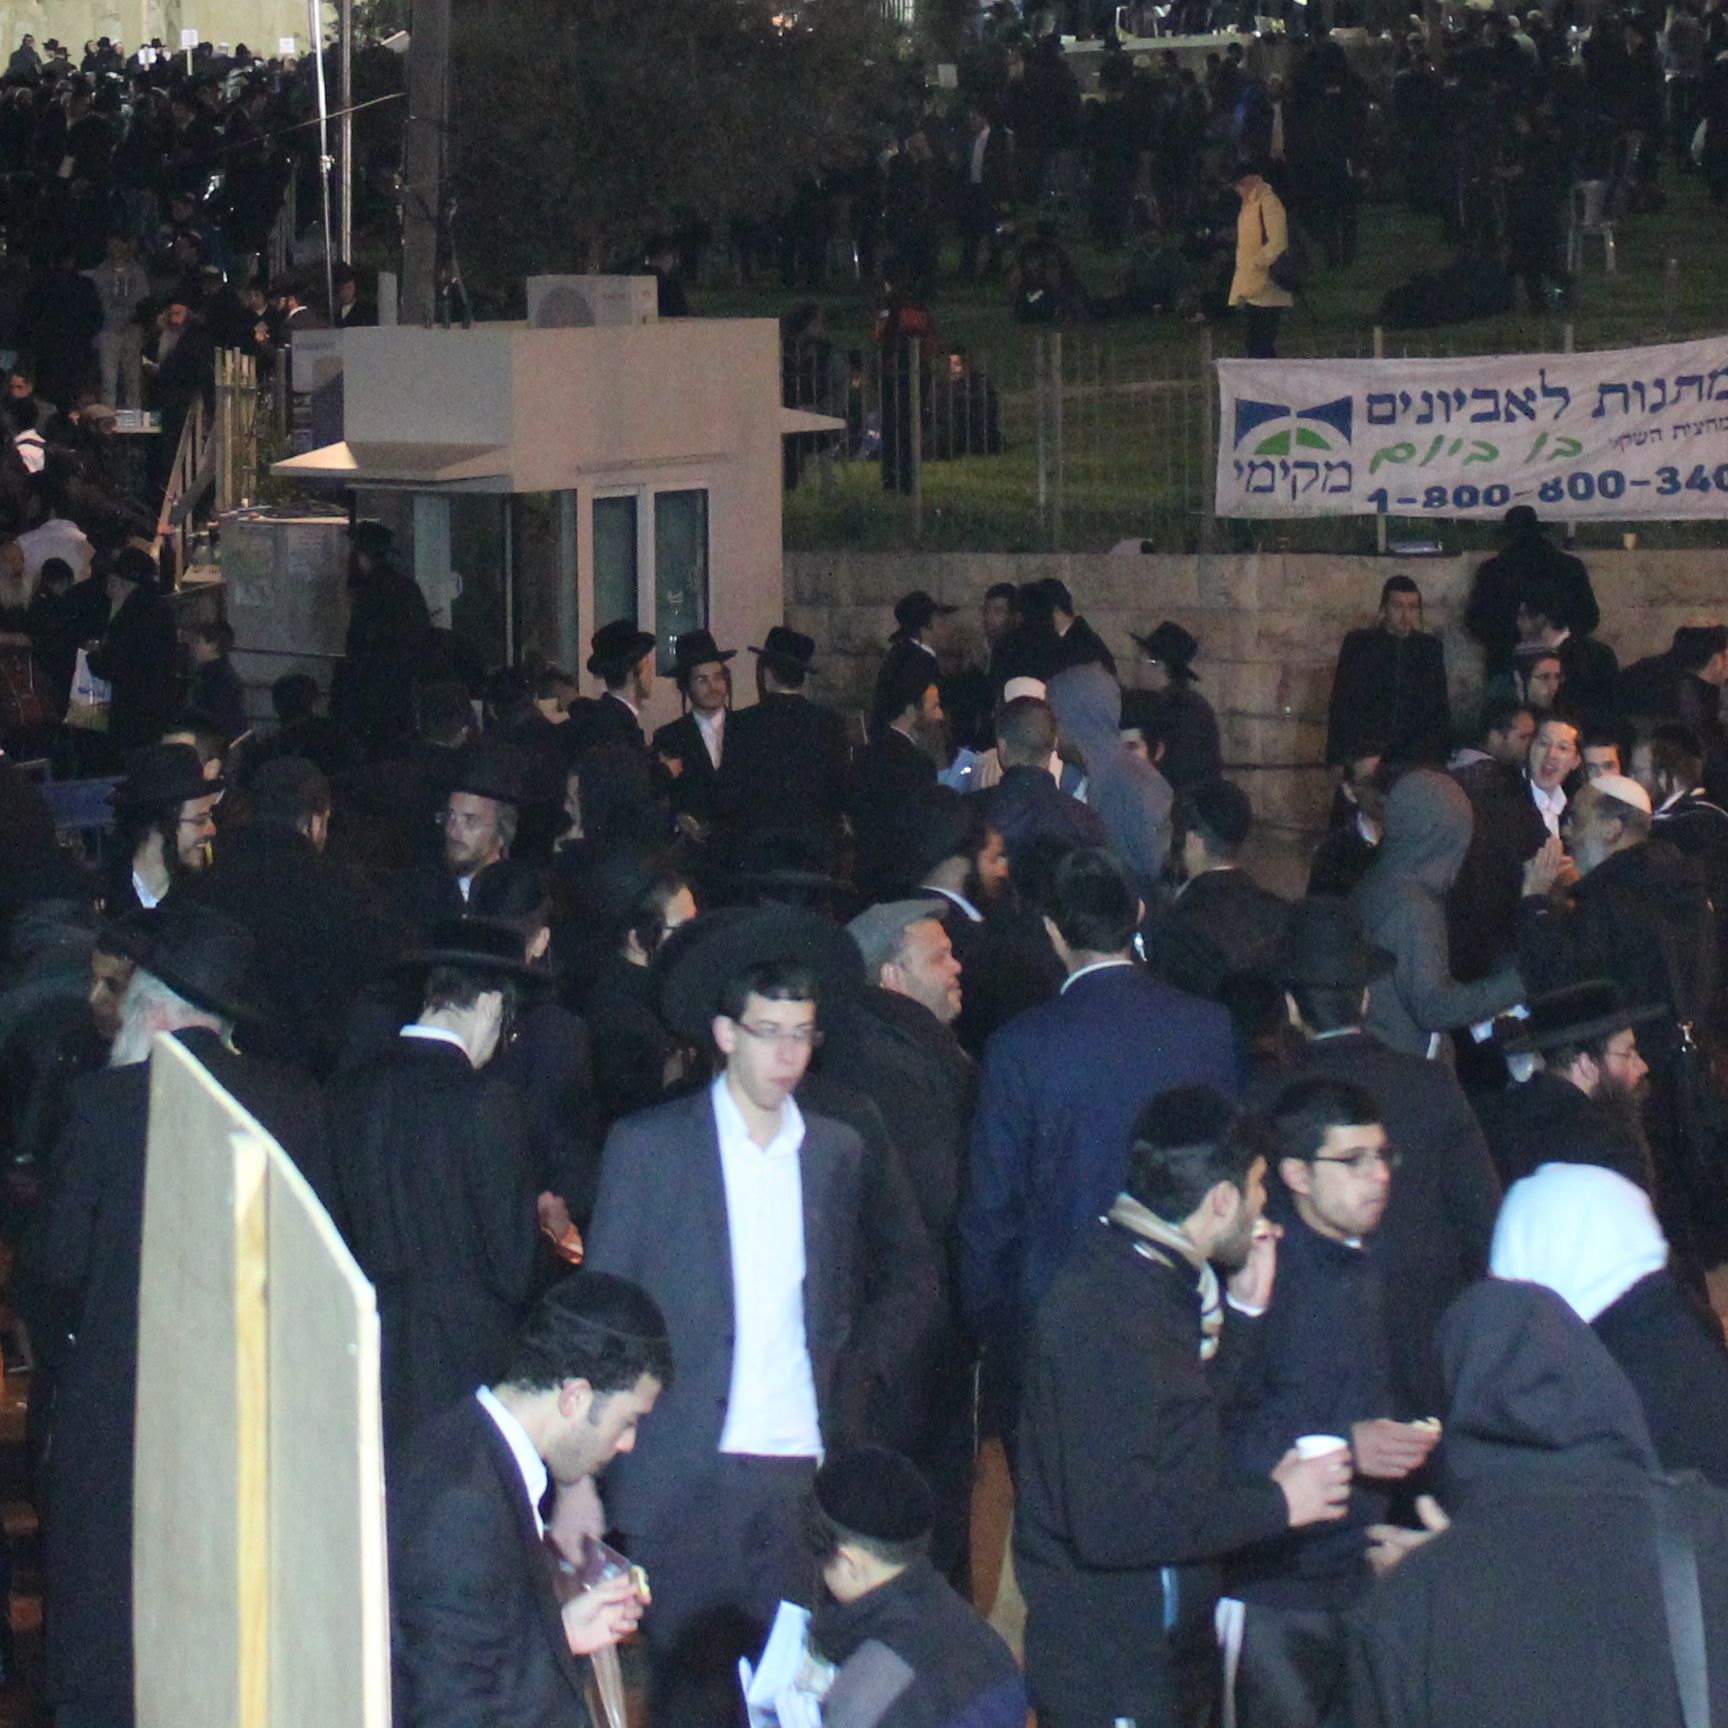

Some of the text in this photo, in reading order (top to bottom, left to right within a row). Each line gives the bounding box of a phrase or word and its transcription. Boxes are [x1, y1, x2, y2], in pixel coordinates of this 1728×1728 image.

[1367, 368, 1571, 425] לאביונים
[1368, 434, 1500, 476] ביום
[1233, 459, 1353, 502] מקימי
